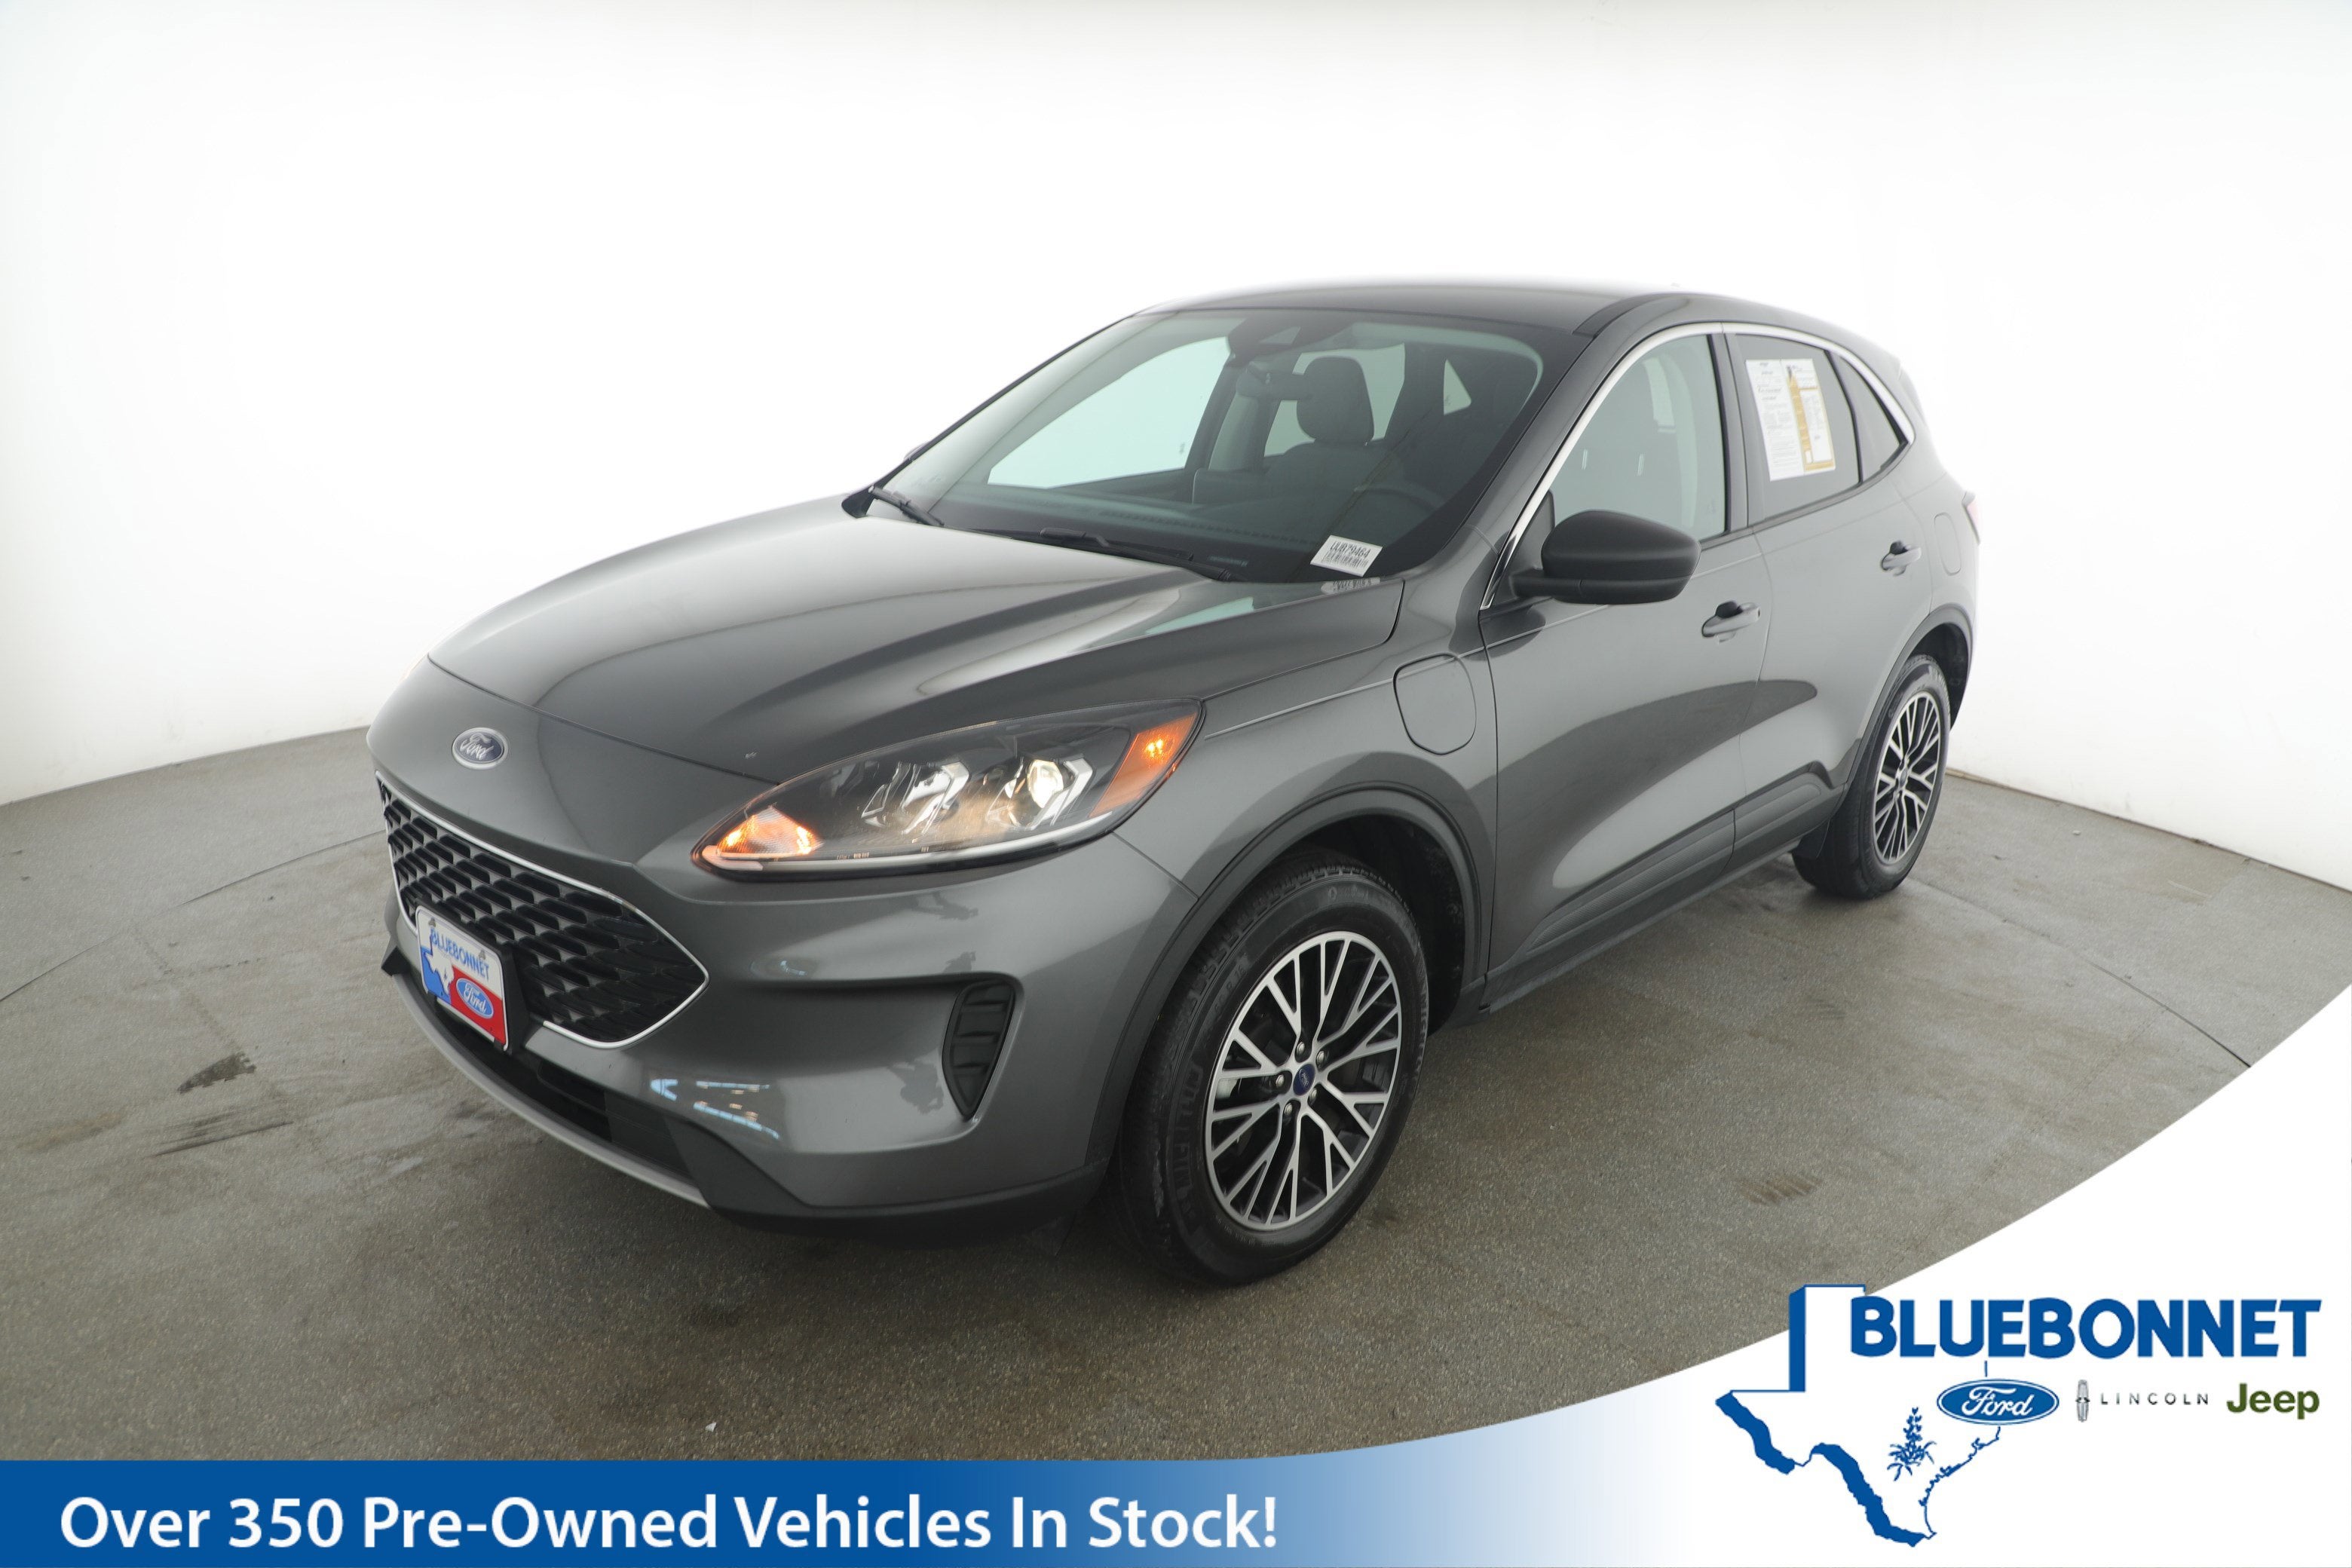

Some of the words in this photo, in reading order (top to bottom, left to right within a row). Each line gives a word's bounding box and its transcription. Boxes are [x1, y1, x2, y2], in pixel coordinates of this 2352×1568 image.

[459, 732, 495, 761] Ford
[430, 927, 490, 982] BLUEBONNET
[463, 982, 487, 1015] Ford
